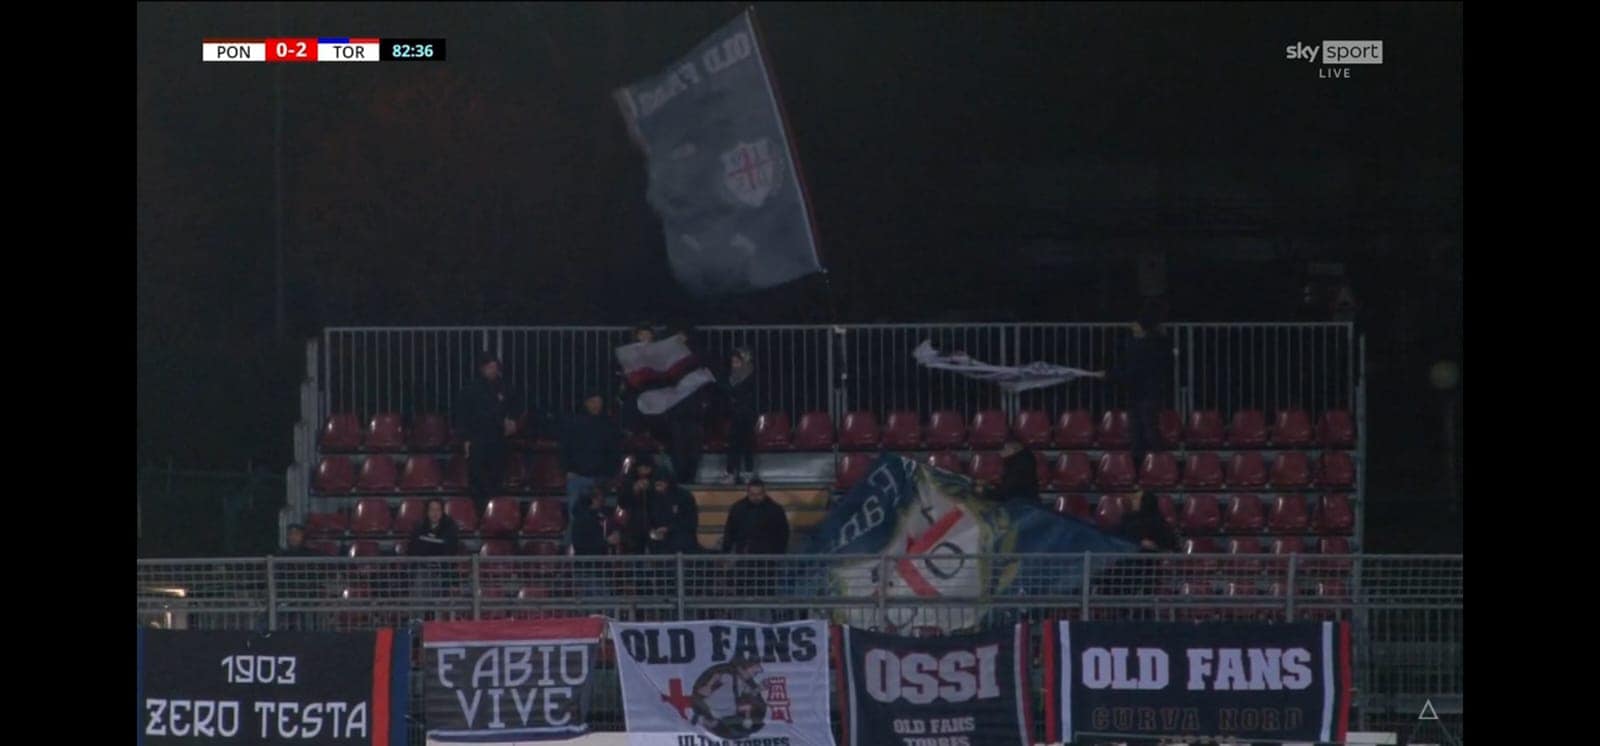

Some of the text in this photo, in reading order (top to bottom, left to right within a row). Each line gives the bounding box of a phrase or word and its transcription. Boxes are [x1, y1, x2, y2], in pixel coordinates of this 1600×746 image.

[437, 644, 589, 688] FABIO
[620, 626, 818, 665] OLD FANS
[221, 655, 297, 684] 1903
[866, 643, 1001, 705] OSSI
[1081, 646, 1313, 692] OLD FANS
[145, 698, 368, 739] ZERO TESTA
[456, 687, 572, 728] VIVE
[892, 716, 977, 734] OLD FANS
[1091, 706, 1303, 732] CURVA NORD
